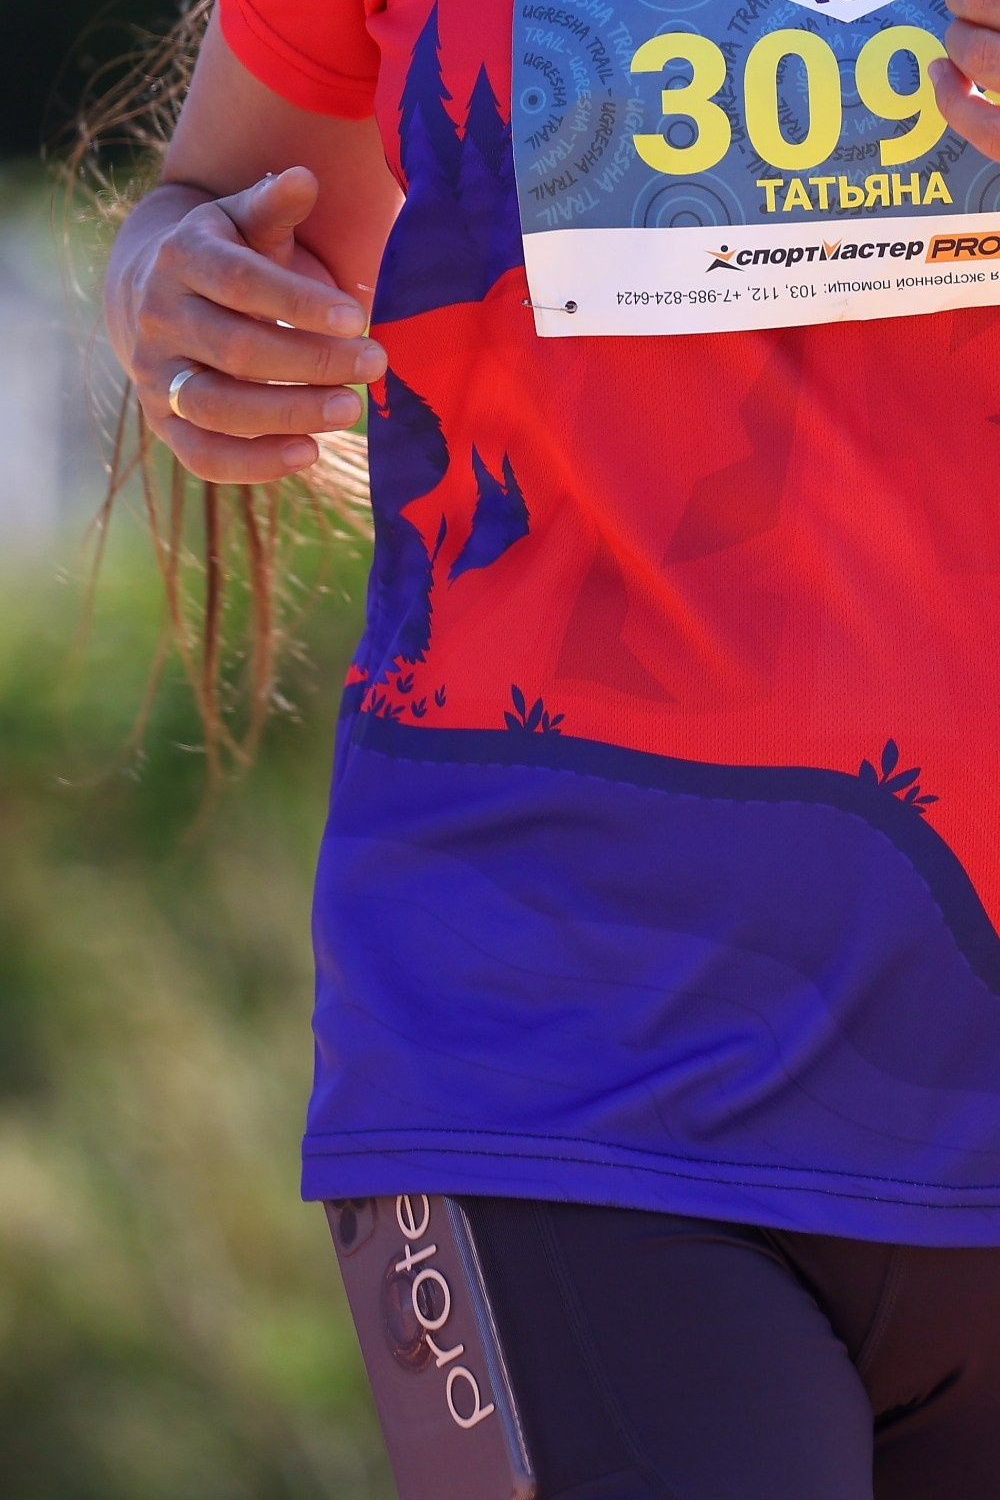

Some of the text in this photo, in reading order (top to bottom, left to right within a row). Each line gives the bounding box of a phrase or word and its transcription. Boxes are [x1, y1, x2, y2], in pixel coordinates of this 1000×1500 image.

[522, 4, 591, 42] UGRESHA
[756, 171, 954, 213] ТАТЬЯНА
[823, 279, 891, 294] помощи:
[896, 272, 986, 291] экстренной
[616, 289, 742, 305] +7-985-824-6424
[747, 285, 779, 301] 112,
[786, 284, 817, 298] 103,
